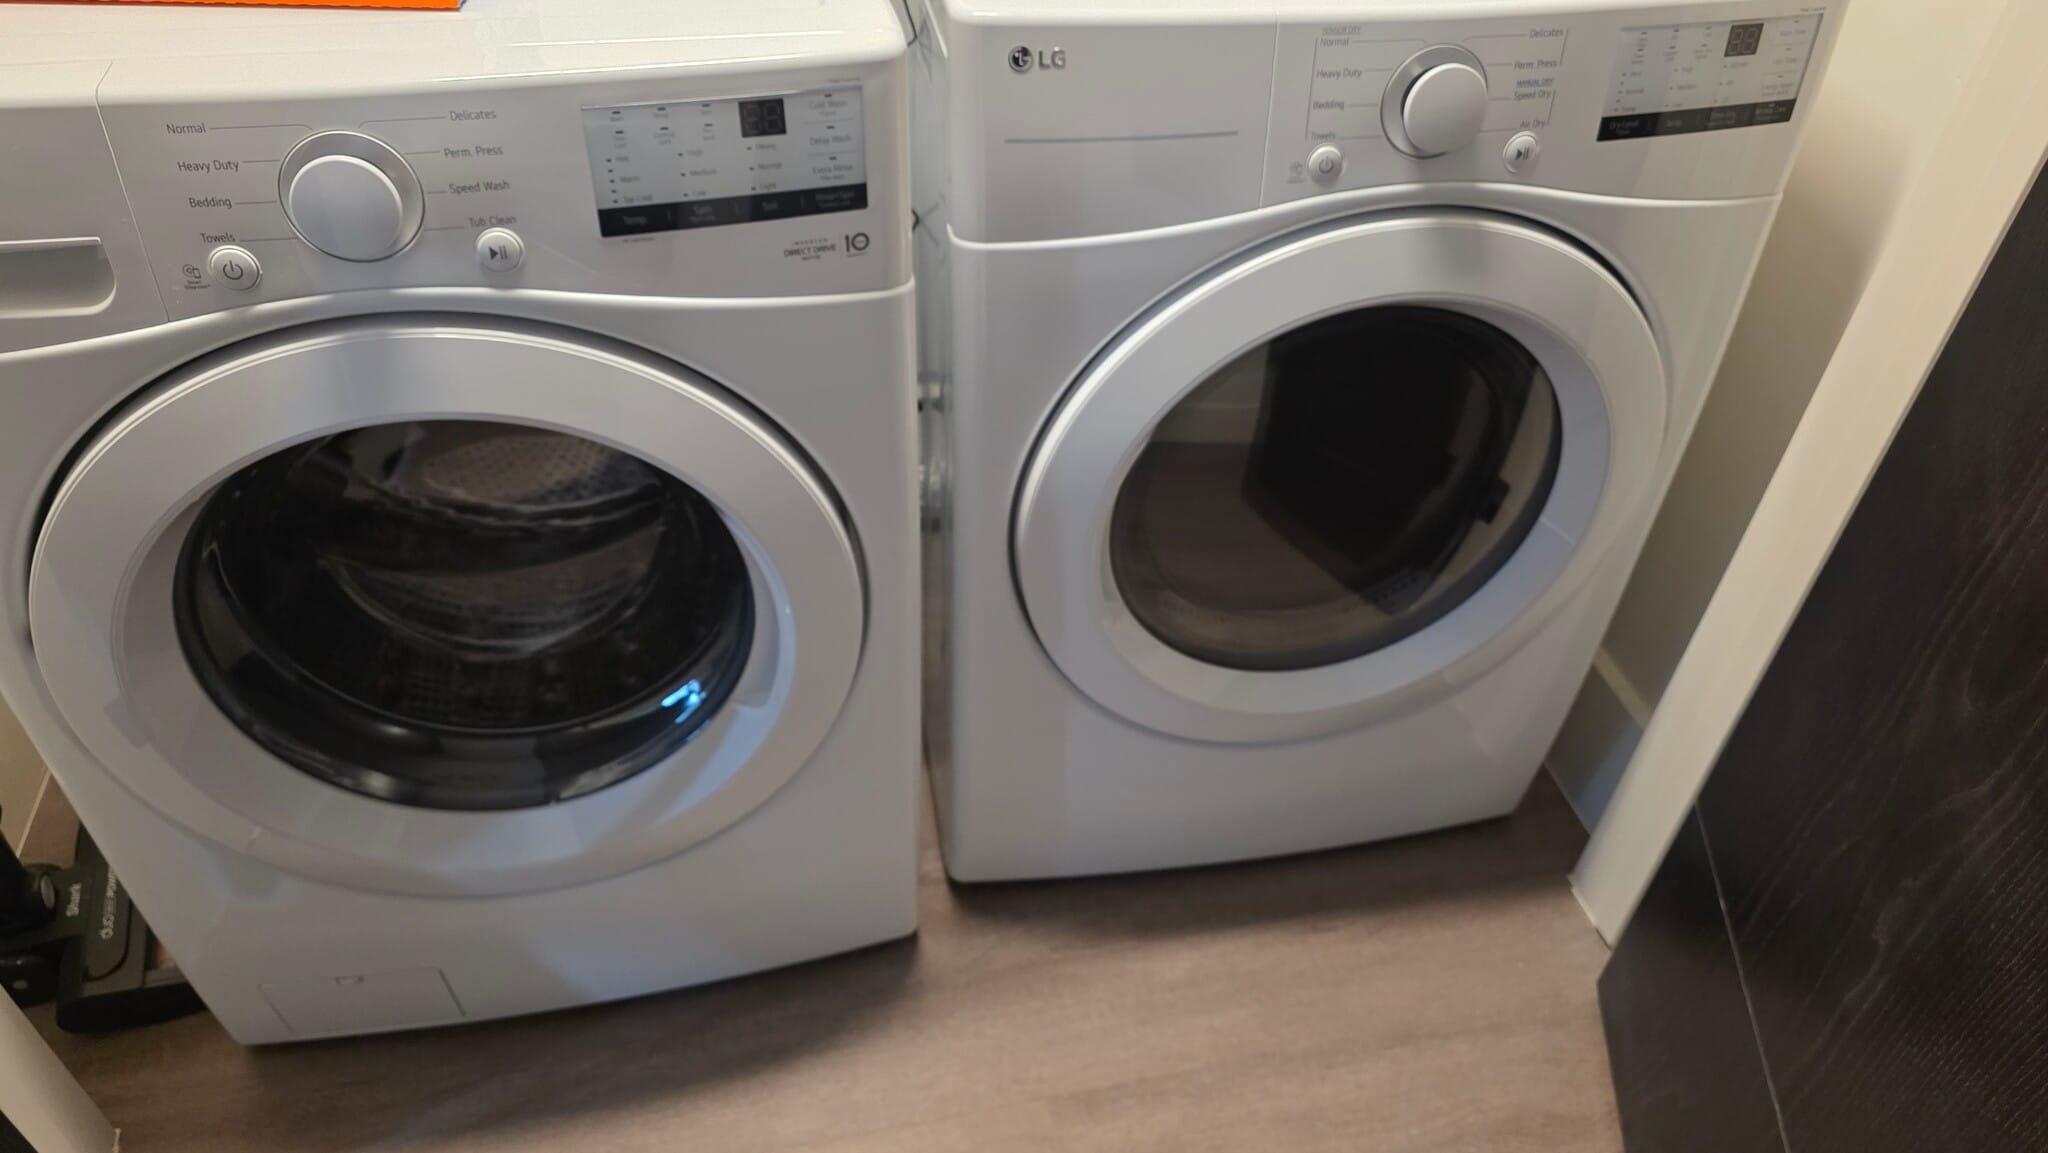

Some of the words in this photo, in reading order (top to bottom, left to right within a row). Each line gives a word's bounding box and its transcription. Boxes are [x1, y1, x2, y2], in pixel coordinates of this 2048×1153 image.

[1529, 28, 1564, 39] Delicates
[1320, 36, 1350, 47] Normal
[1038, 46, 1066, 70] LG
[1316, 68, 1341, 80] Heavy
[1343, 67, 1362, 79] Duty
[1514, 90, 1537, 101] Speed
[1538, 89, 1552, 100] Dry
[1313, 100, 1344, 111] Bedding
[450, 108, 497, 121] Delicates
[166, 122, 207, 135] Normal
[1520, 119, 1531, 129] Air
[1532, 118, 1546, 129] Dry
[1311, 131, 1336, 141] Towels
[443, 147, 473, 160] Perm.
[475, 144, 503, 157] Press
[177, 160, 211, 173] Heavy
[213, 158, 239, 173] Duty
[449, 181, 481, 195] Speed
[483, 179, 510, 192] Wash
[189, 196, 233, 210] Bedding
[468, 217, 487, 228] Tub
[488, 213, 517, 227] Clean
[200, 231, 236, 244] Towels
[845, 232, 870, 253] 10
